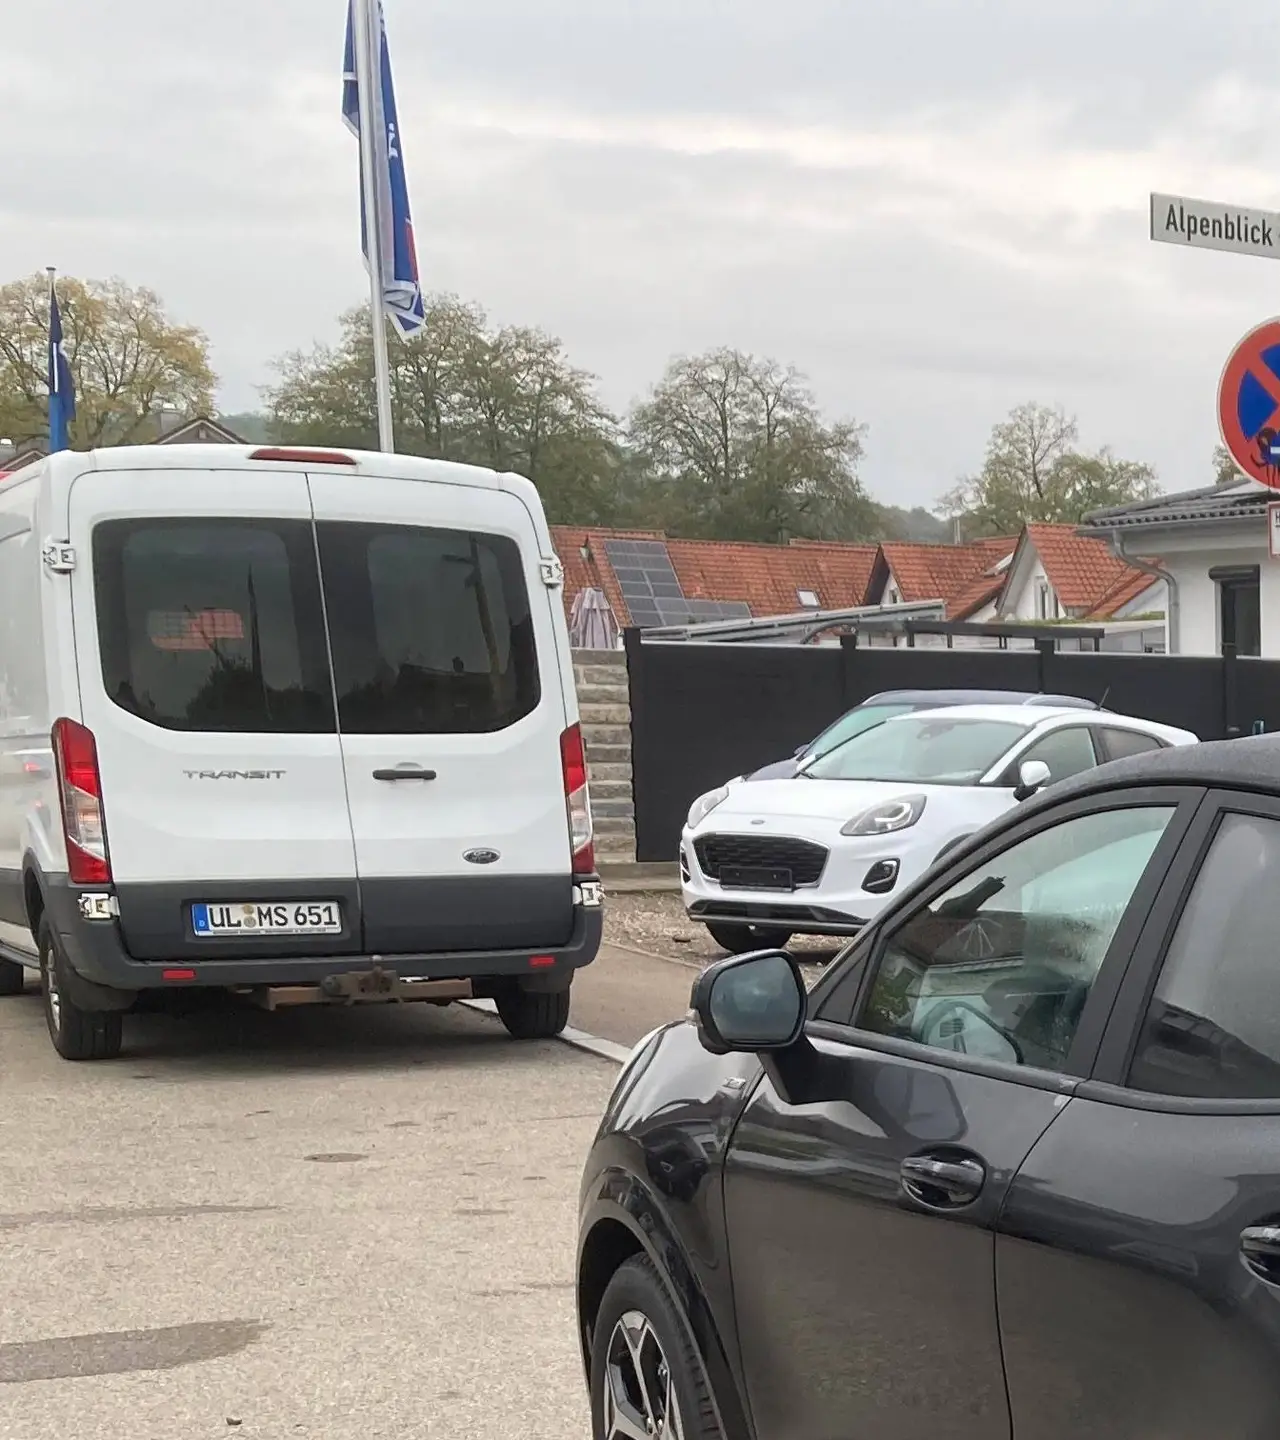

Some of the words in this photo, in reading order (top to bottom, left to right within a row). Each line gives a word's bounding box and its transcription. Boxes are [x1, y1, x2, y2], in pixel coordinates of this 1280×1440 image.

[1165, 203, 1273, 246] Alpenblick
[182, 770, 287, 779] TRANSIT
[209, 907, 241, 928] UL
[257, 906, 288, 926] MS
[294, 905, 337, 926] 651
